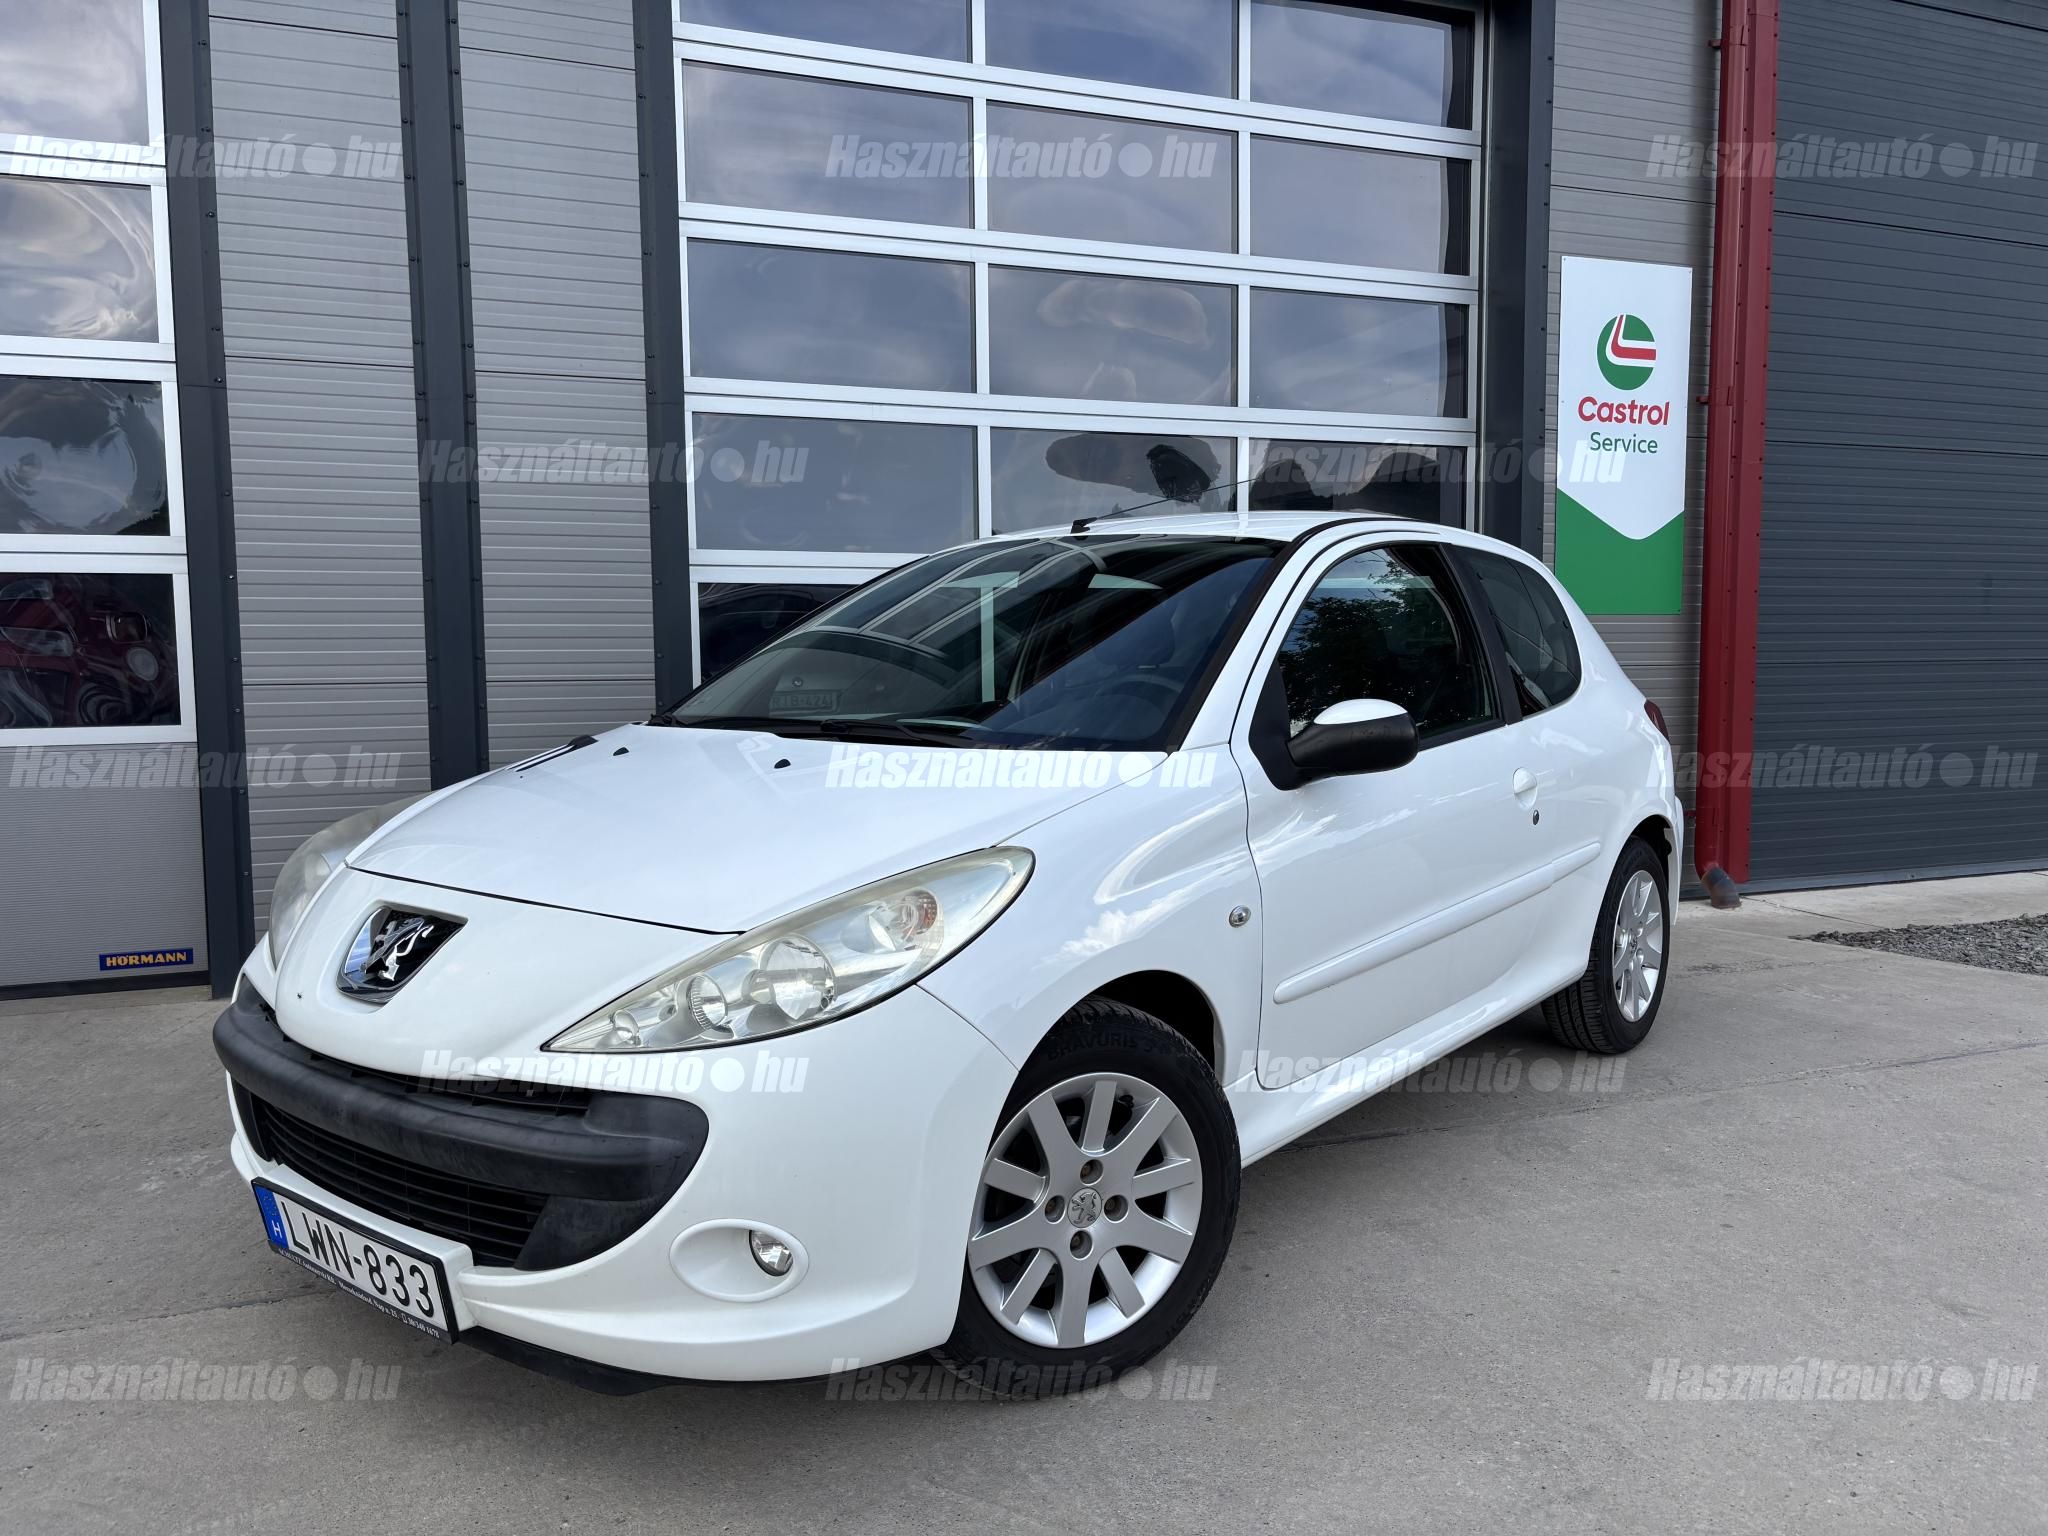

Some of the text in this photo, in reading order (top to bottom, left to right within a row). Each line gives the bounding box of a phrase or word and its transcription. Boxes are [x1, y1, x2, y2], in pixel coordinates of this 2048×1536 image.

[1577, 396, 1671, 426] Castrol
[1589, 432, 1659, 454] Service
[105, 951, 188, 968] HÖRMANN
[272, 1220, 282, 1239] H
[281, 1201, 435, 1318] LWN-833
